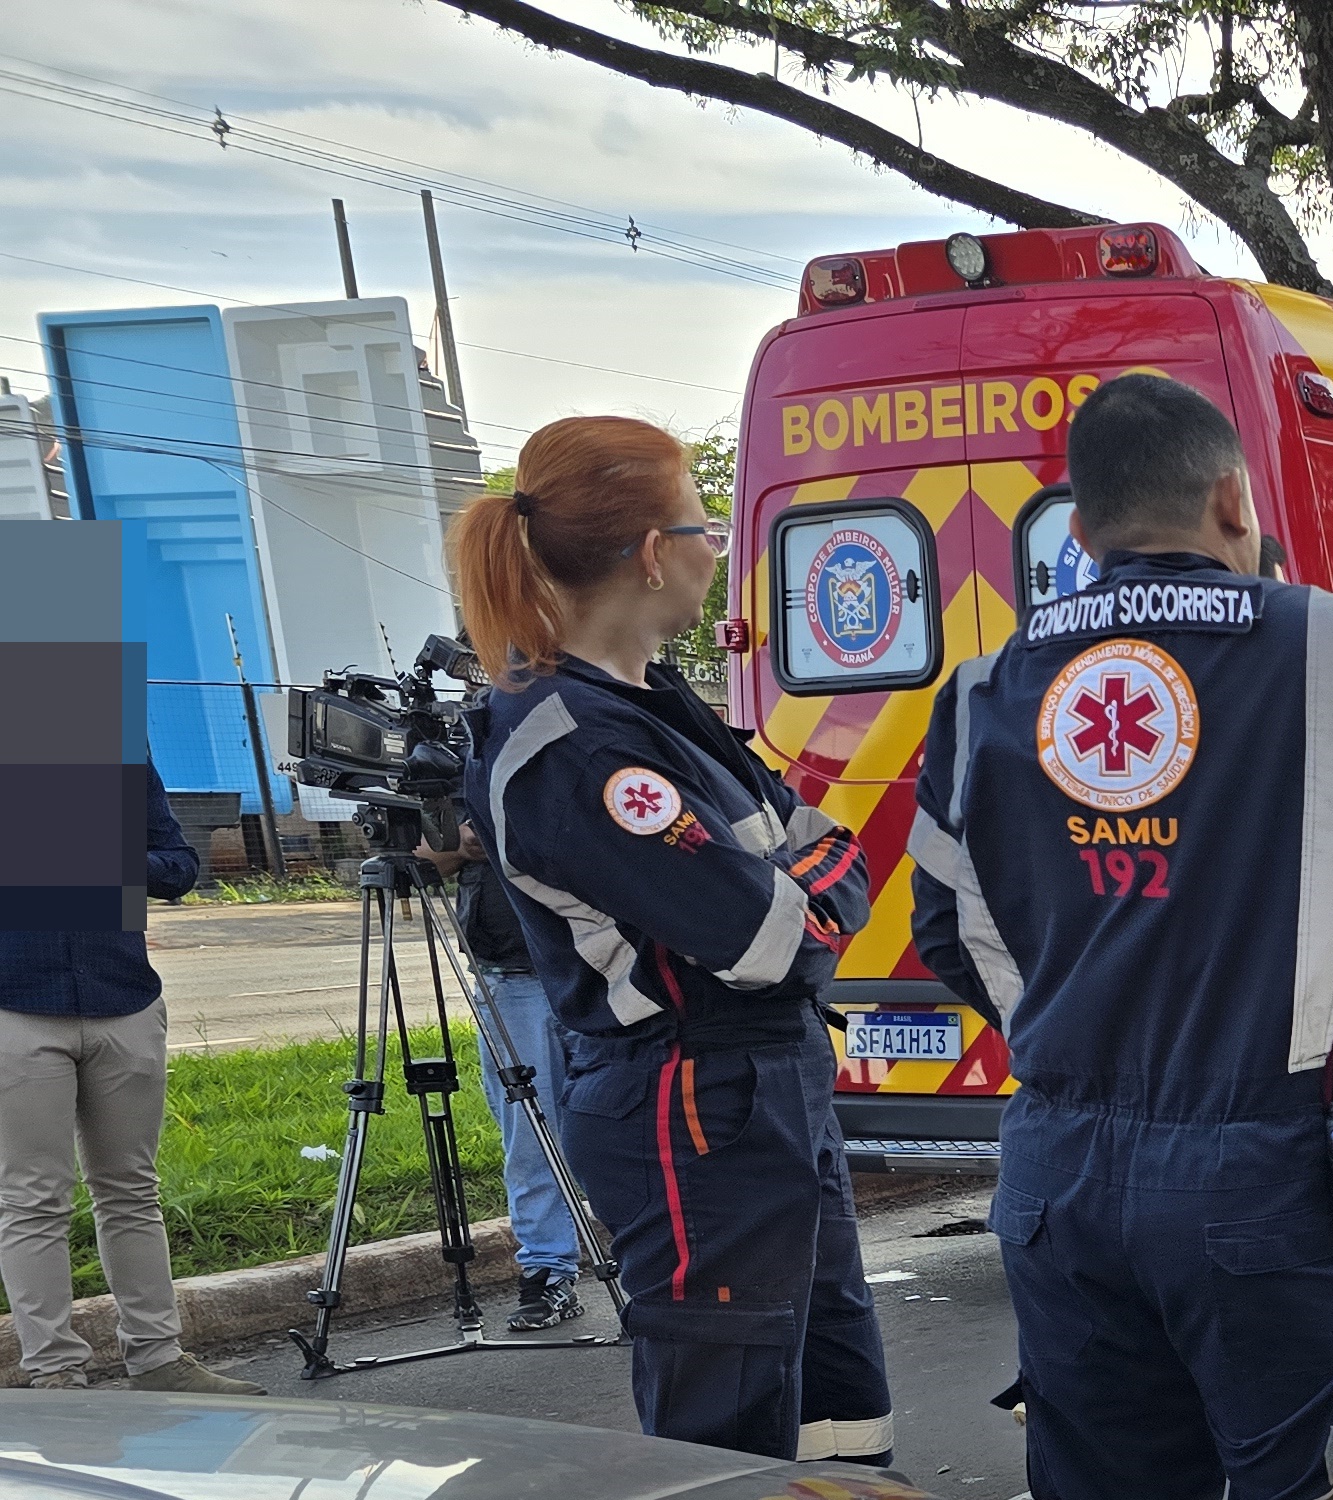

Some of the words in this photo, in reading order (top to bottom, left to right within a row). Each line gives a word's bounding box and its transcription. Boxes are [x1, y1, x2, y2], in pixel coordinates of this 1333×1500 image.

[782, 375, 1100, 456] BOMBEIROS
[808, 573, 818, 622] CORPO
[814, 551, 827, 570] DE
[882, 556, 900, 615] MILITAR
[1028, 592, 1115, 642] CONDUTOR
[1119, 583, 1254, 625] SOCORRISTA
[1041, 694, 1058, 740] SERVIÇO
[1054, 679, 1069, 694] DE
[1065, 644, 1132, 681] ATENDIMENTO
[1133, 642, 1166, 669] MÓVEL
[1162, 666, 1177, 682] DE
[1171, 678, 1197, 740] URGÊNCIA
[1047, 757, 1091, 801] SISTEMA
[1138, 788, 1157, 802] DE
[1156, 756, 1187, 791] SAÚDE
[664, 810, 698, 846] SAMU
[1067, 815, 1178, 846] SAMU
[1079, 849, 1171, 899] 192
[856, 1027, 946, 1054] SFA1H13
